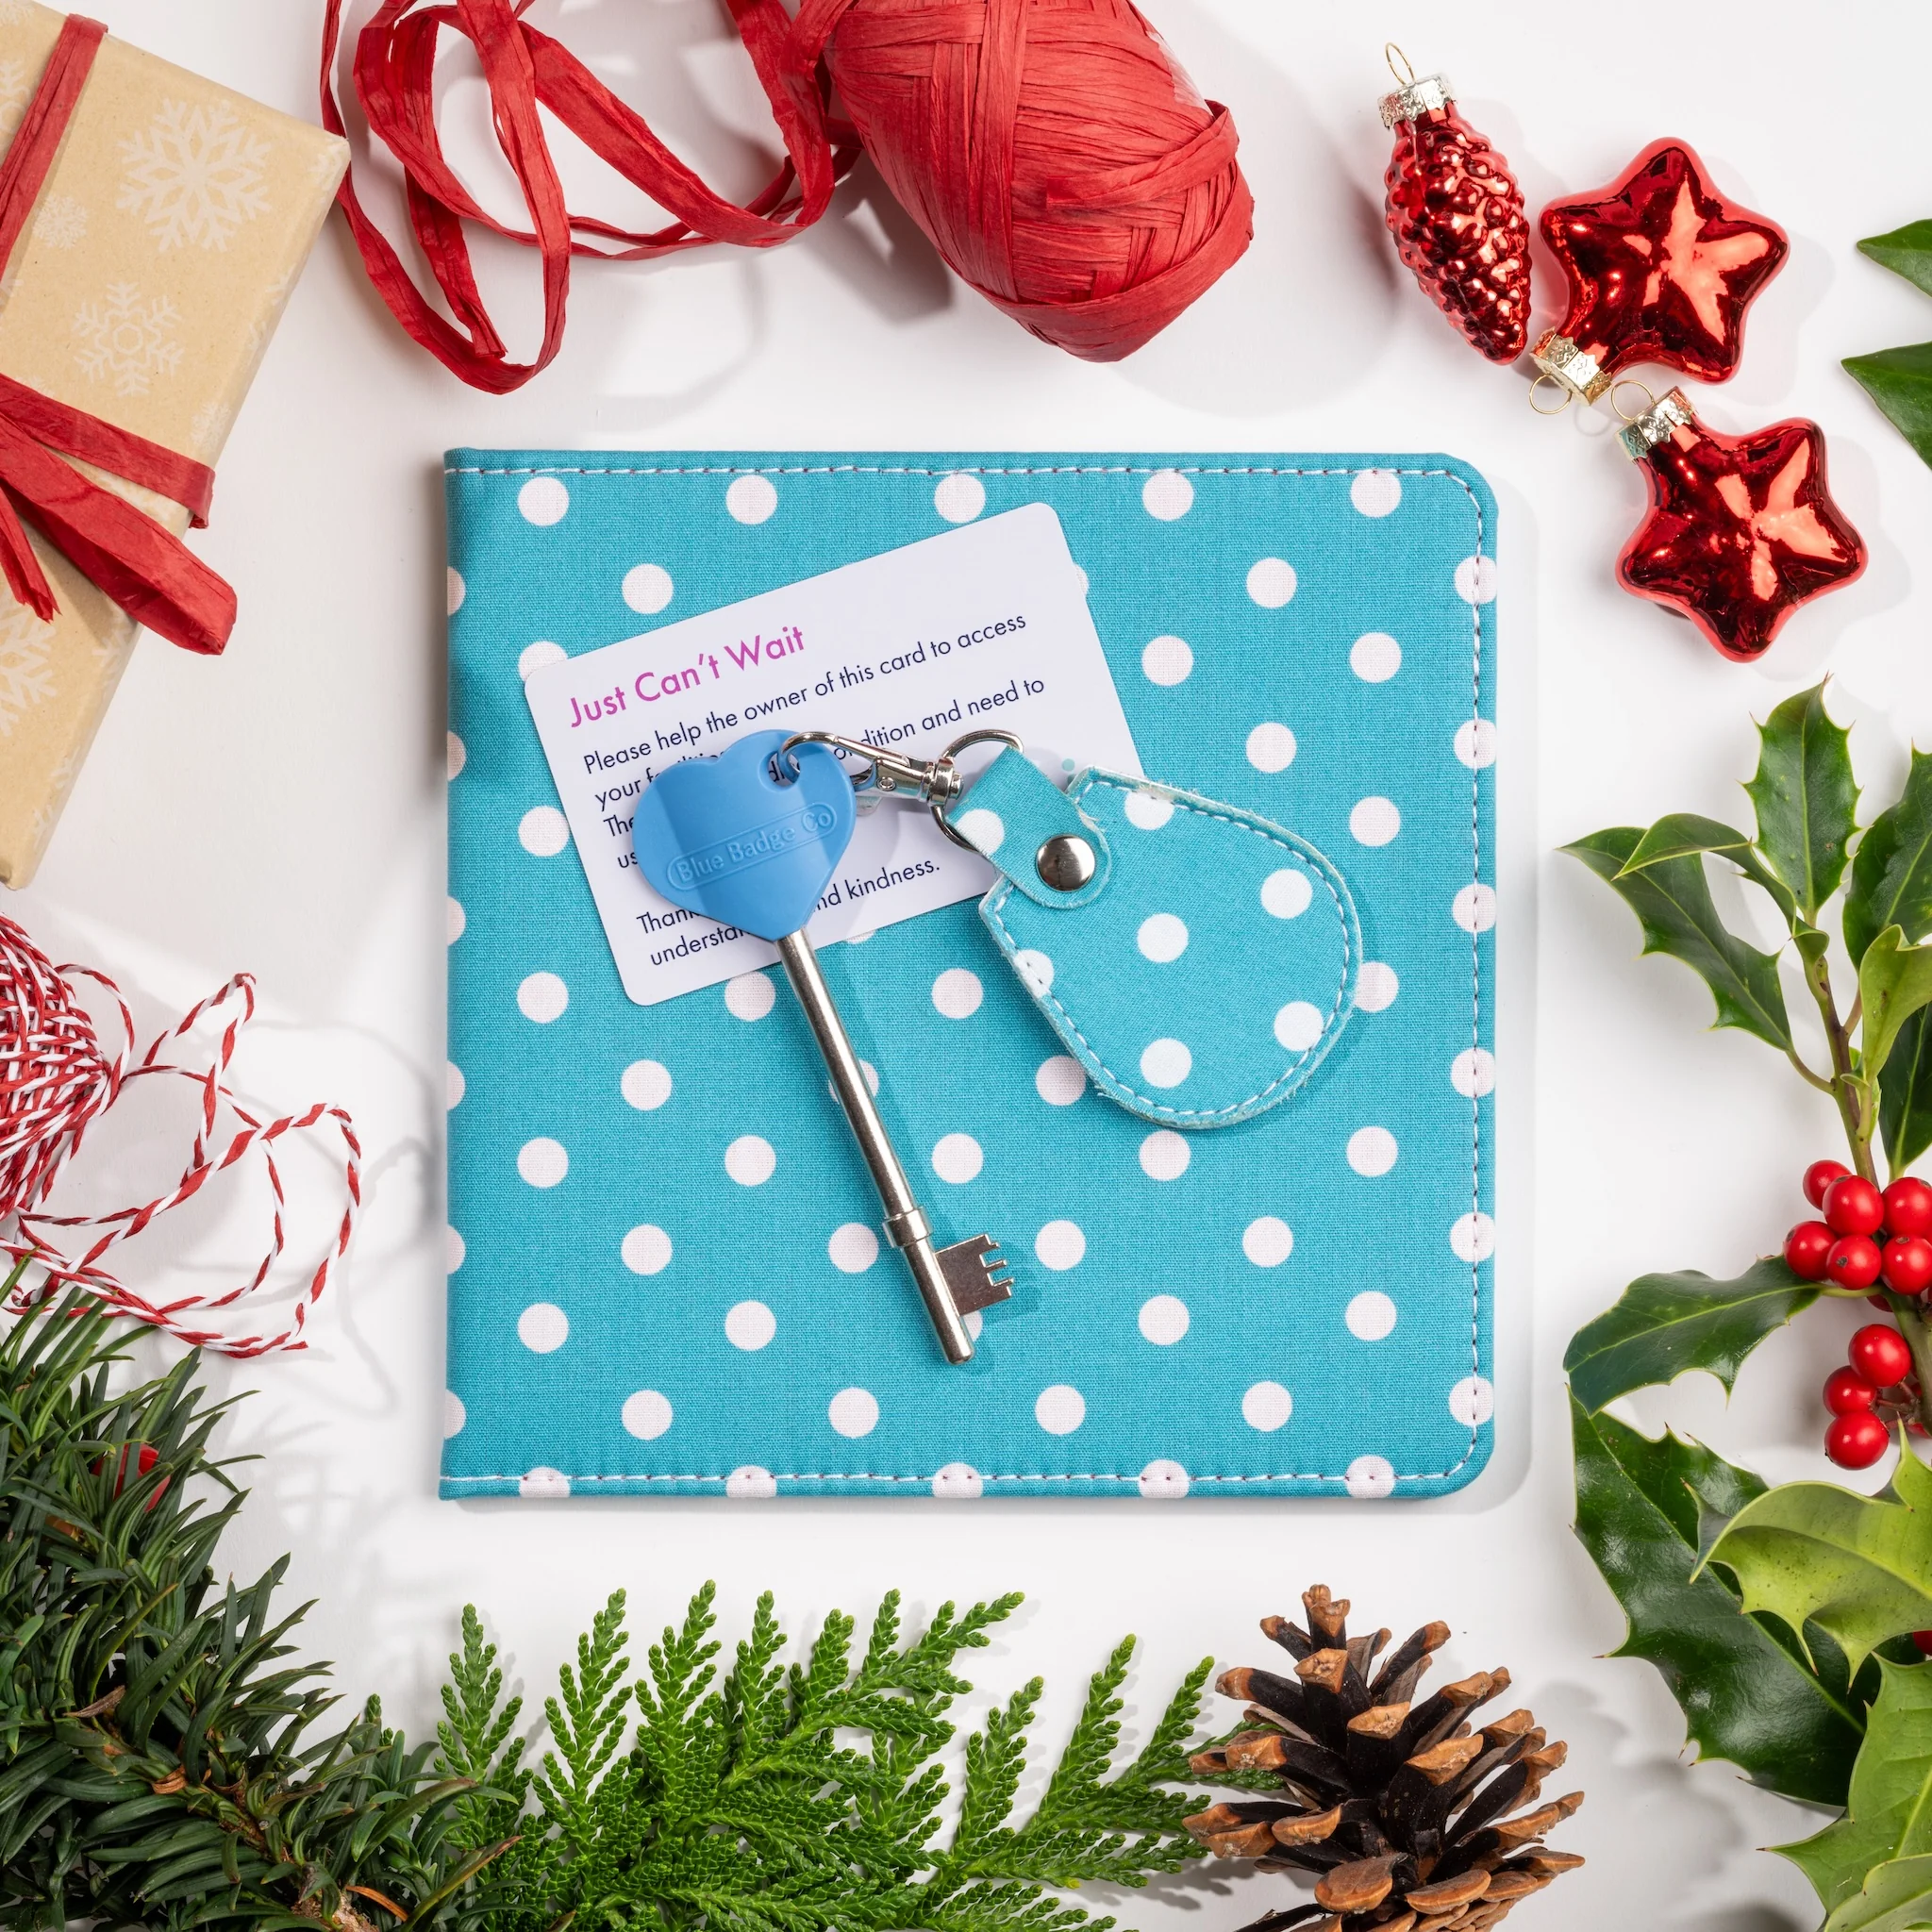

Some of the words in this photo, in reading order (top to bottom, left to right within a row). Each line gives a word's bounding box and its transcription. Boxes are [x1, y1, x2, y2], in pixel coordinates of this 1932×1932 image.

[571, 686, 626, 727] Just
[634, 654, 720, 701] Can't
[724, 626, 805, 671] Wait
[583, 742, 652, 774] Please
[655, 722, 701, 746] help
[706, 711, 738, 734] the
[744, 688, 808, 721] owner
[815, 672, 835, 696] of
[839, 666, 874, 689] this
[879, 641, 926, 675] card
[930, 641, 952, 658] to
[958, 615, 1026, 648] access
[922, 700, 961, 731] and
[967, 680, 1020, 716] need
[1024, 678, 1044, 697] to
[594, 779, 641, 812] your
[675, 853, 724, 883] Blue
[726, 826, 796, 864] Badge
[802, 811, 832, 832] Co
[813, 883, 842, 912] nd
[844, 859, 941, 900] kindness.
